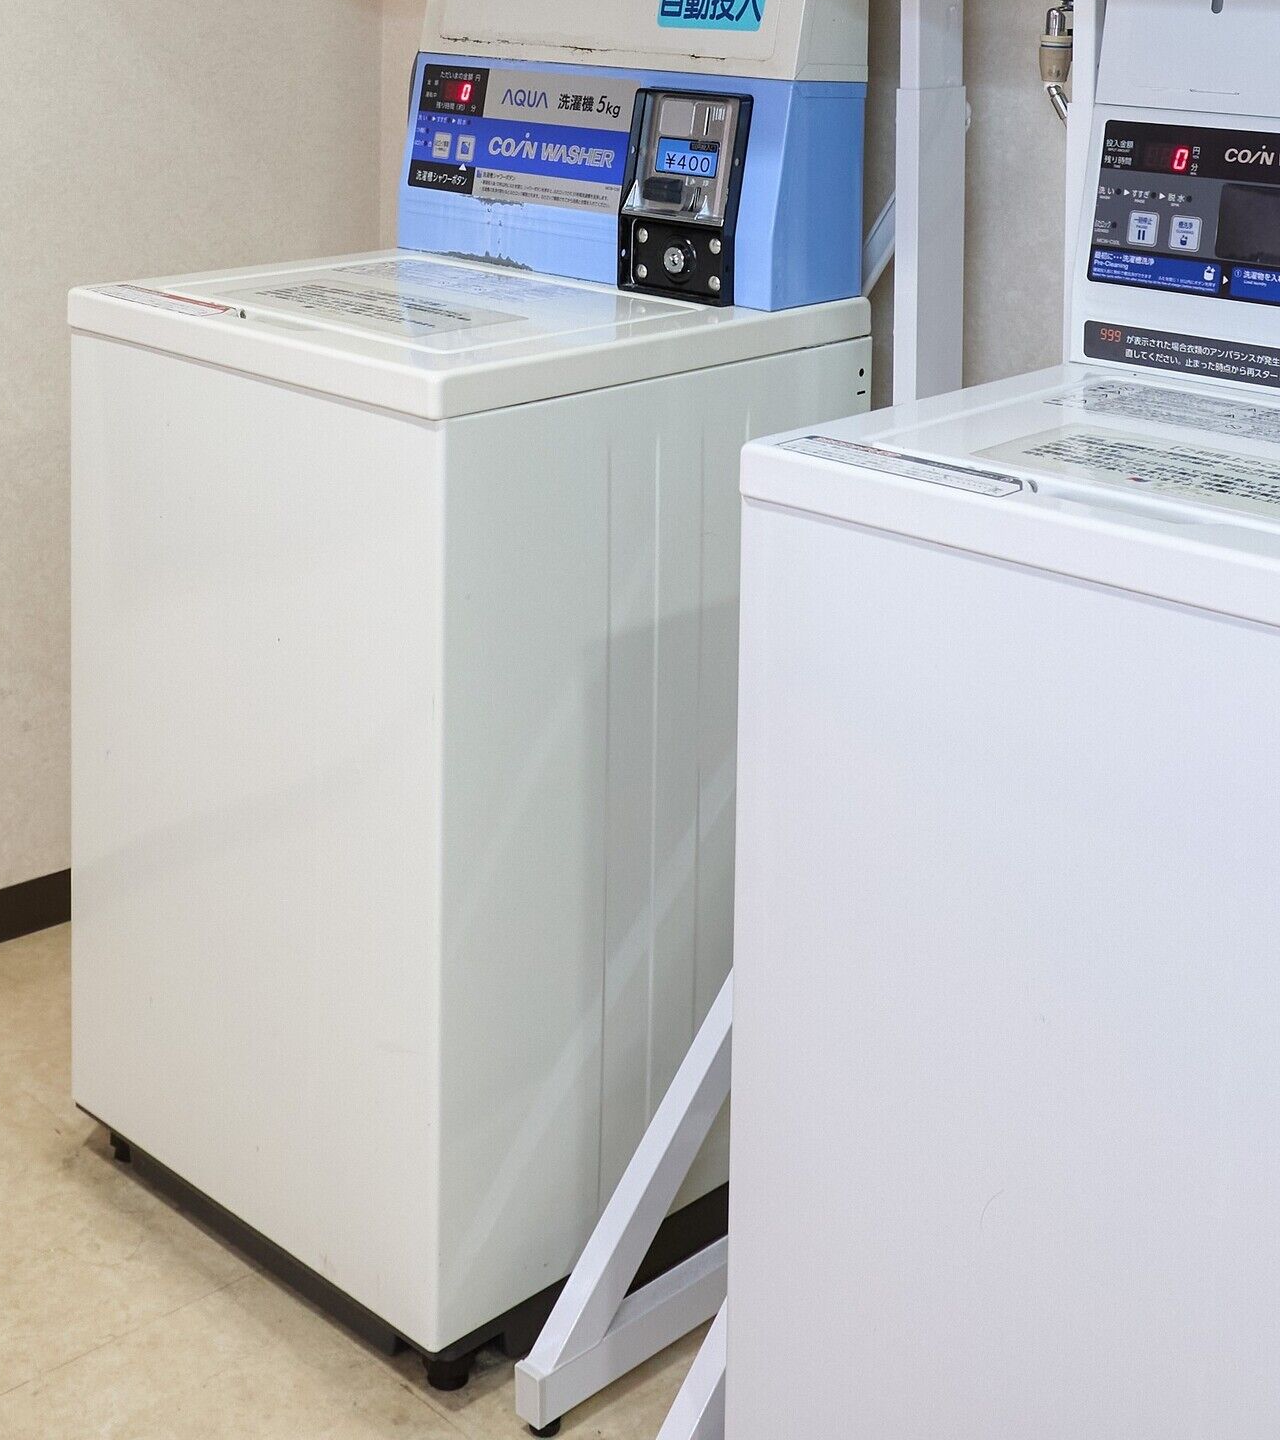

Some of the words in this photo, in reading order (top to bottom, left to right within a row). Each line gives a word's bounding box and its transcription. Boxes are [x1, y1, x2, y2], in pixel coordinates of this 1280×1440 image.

[461, 83, 471, 101] 0
[501, 88, 548, 109] AQUA
[557, 93, 595, 113] 洗濯機
[596, 94, 622, 119] 5kg
[488, 131, 538, 160] COIN
[541, 142, 615, 169] WASHER
[1106, 139, 1134, 149] 投入金額
[1192, 146, 1201, 155] 円
[666, 152, 710, 173] ¥400
[1104, 155, 1132, 166] 残り時間
[1173, 148, 1189, 170] 0
[1224, 144, 1274, 166] COIN
[1190, 163, 1199, 172] 分
[1131, 189, 1151, 199] すすぎ
[1167, 193, 1185, 203] 脱水
[1093, 259, 1129, 270] Pre-Cleaning
[1100, 328, 1121, 343] 999
